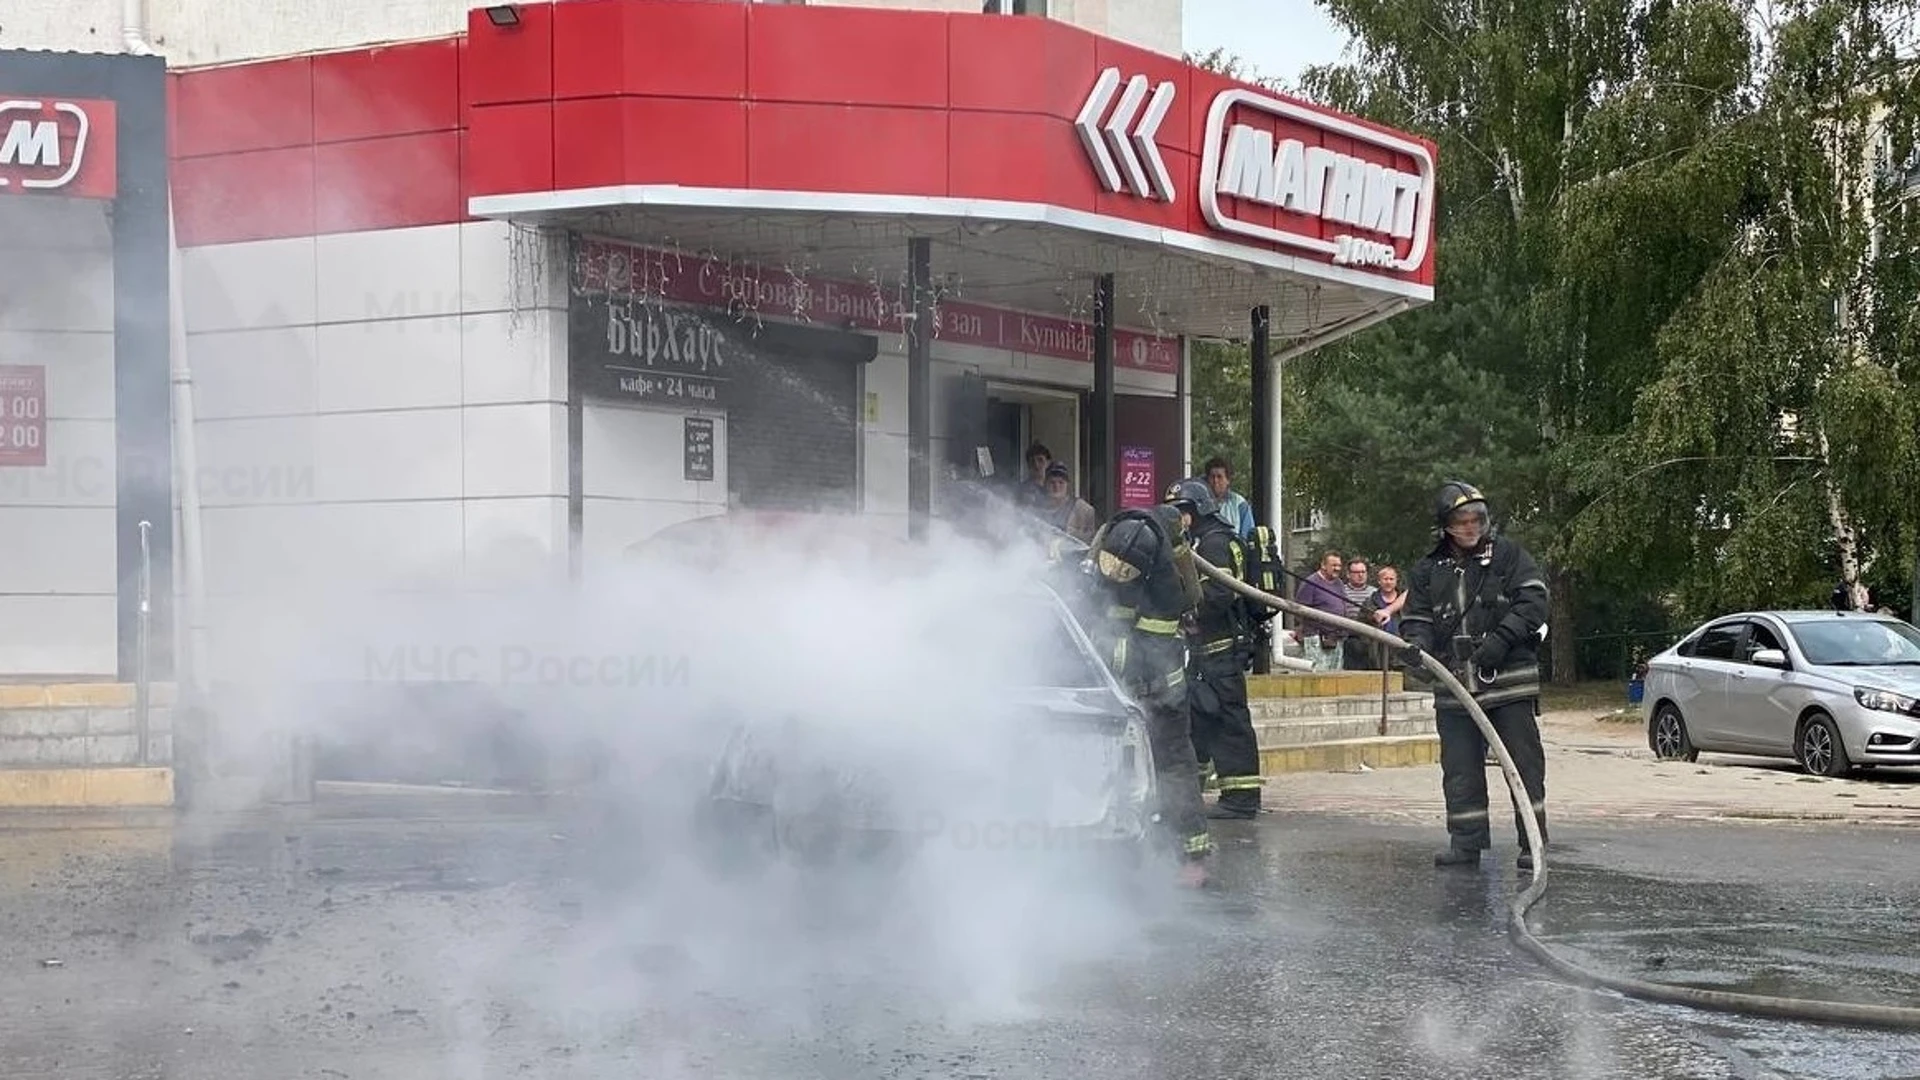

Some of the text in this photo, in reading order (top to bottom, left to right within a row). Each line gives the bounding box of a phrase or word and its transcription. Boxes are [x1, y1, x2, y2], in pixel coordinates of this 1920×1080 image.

[1217, 124, 1422, 239] МАГНИТ
[608, 304, 726, 371] БирХаус
[950, 311, 982, 337] зал
[1021, 318, 1117, 361] Кулинар
[619, 375, 716, 400] кафе 24 часа
[1125, 471, 1151, 485] 8-22
